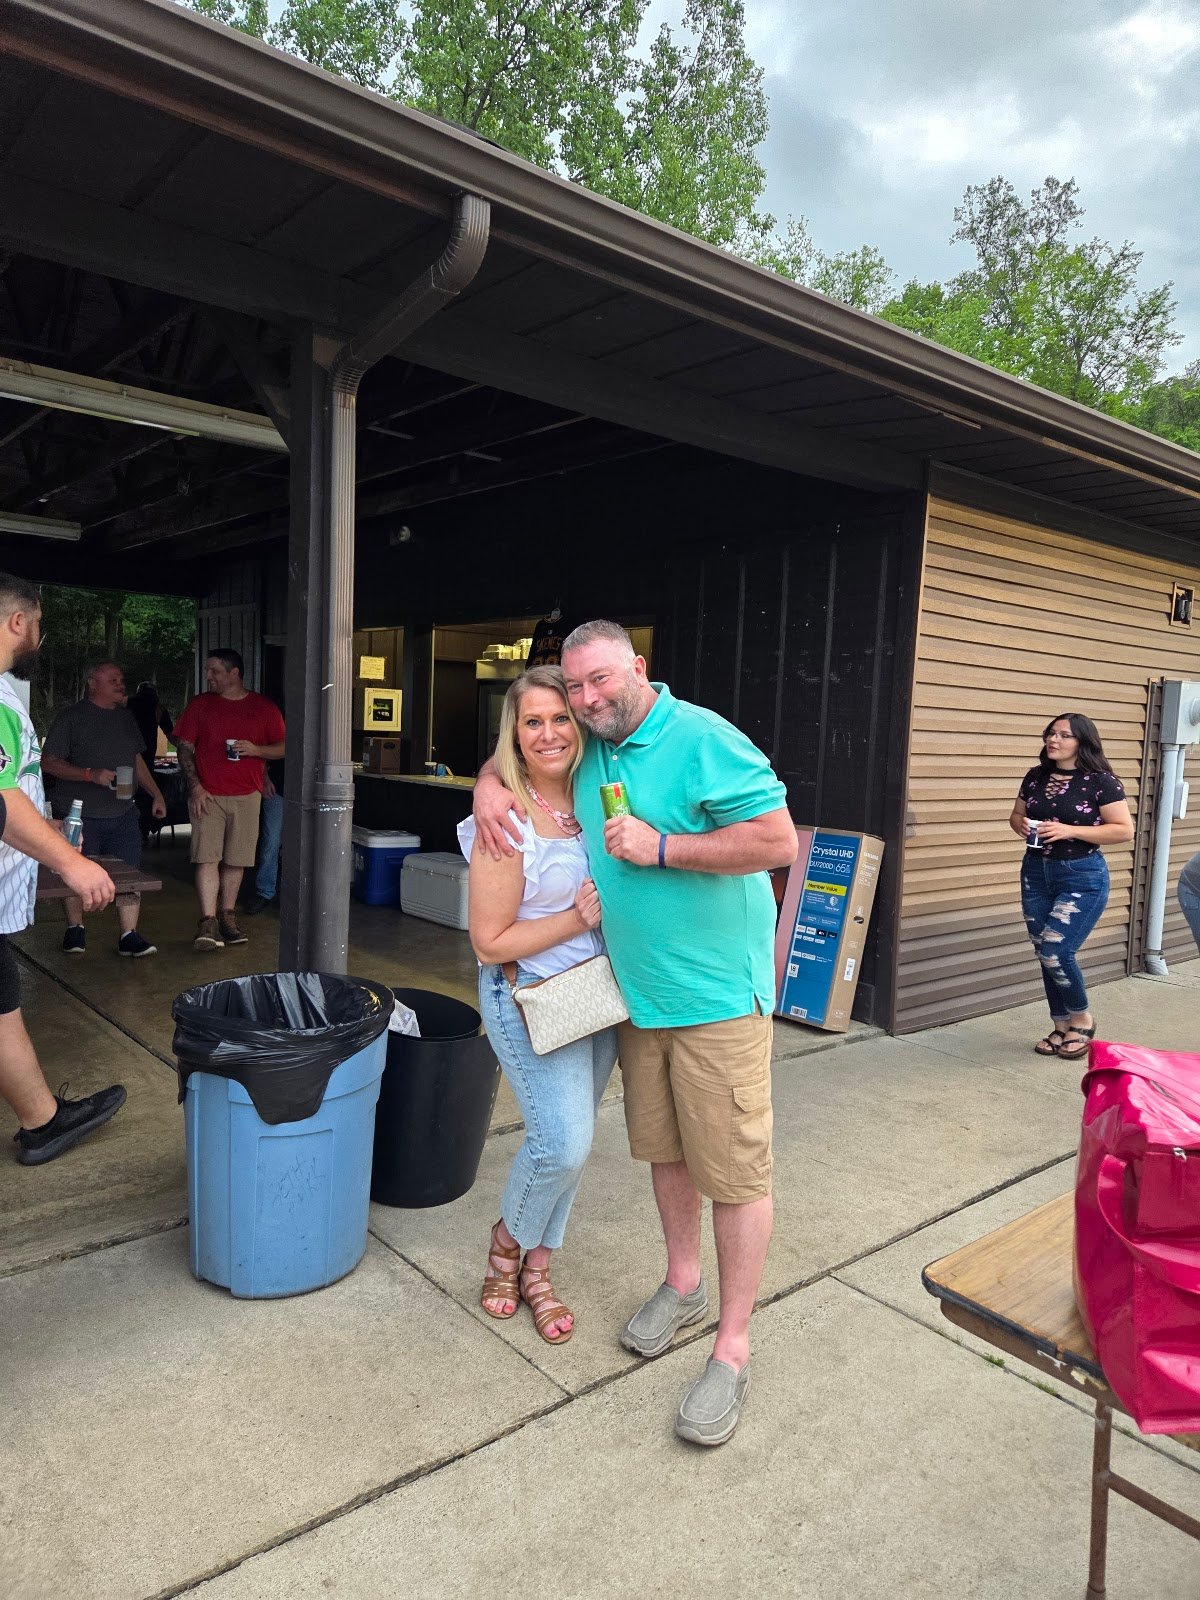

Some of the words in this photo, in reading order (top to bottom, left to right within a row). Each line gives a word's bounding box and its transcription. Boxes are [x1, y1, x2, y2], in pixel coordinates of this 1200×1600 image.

[812, 846, 838, 856] Crystal
[839, 849, 854, 858] UHD
[835, 863, 846, 873] 65
[807, 882, 825, 890] Member
